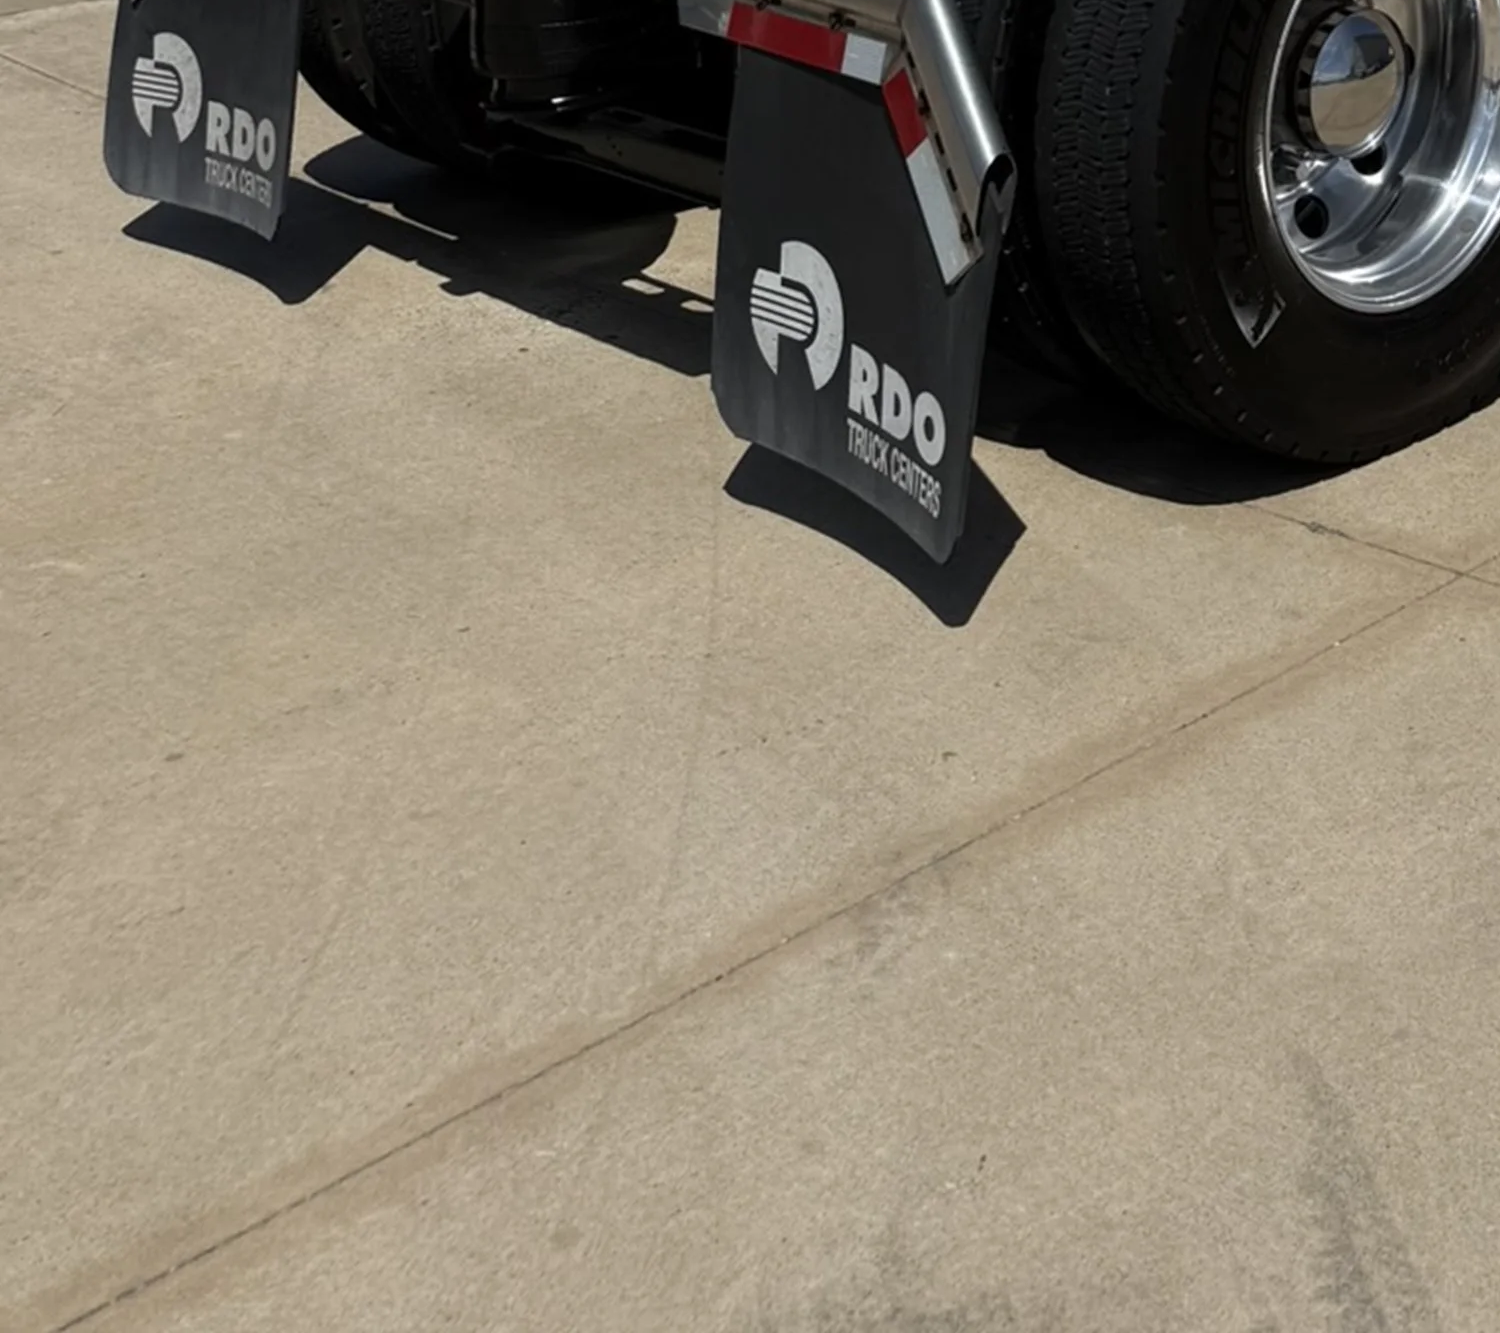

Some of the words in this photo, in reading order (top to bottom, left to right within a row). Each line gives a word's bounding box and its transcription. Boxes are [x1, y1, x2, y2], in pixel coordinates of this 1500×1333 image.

[204, 156, 239, 193] TRUCK
[205, 100, 276, 172] RDO
[848, 343, 946, 466] RDO
[847, 417, 890, 476] TRUCK
[890, 446, 942, 518] CENTERS
